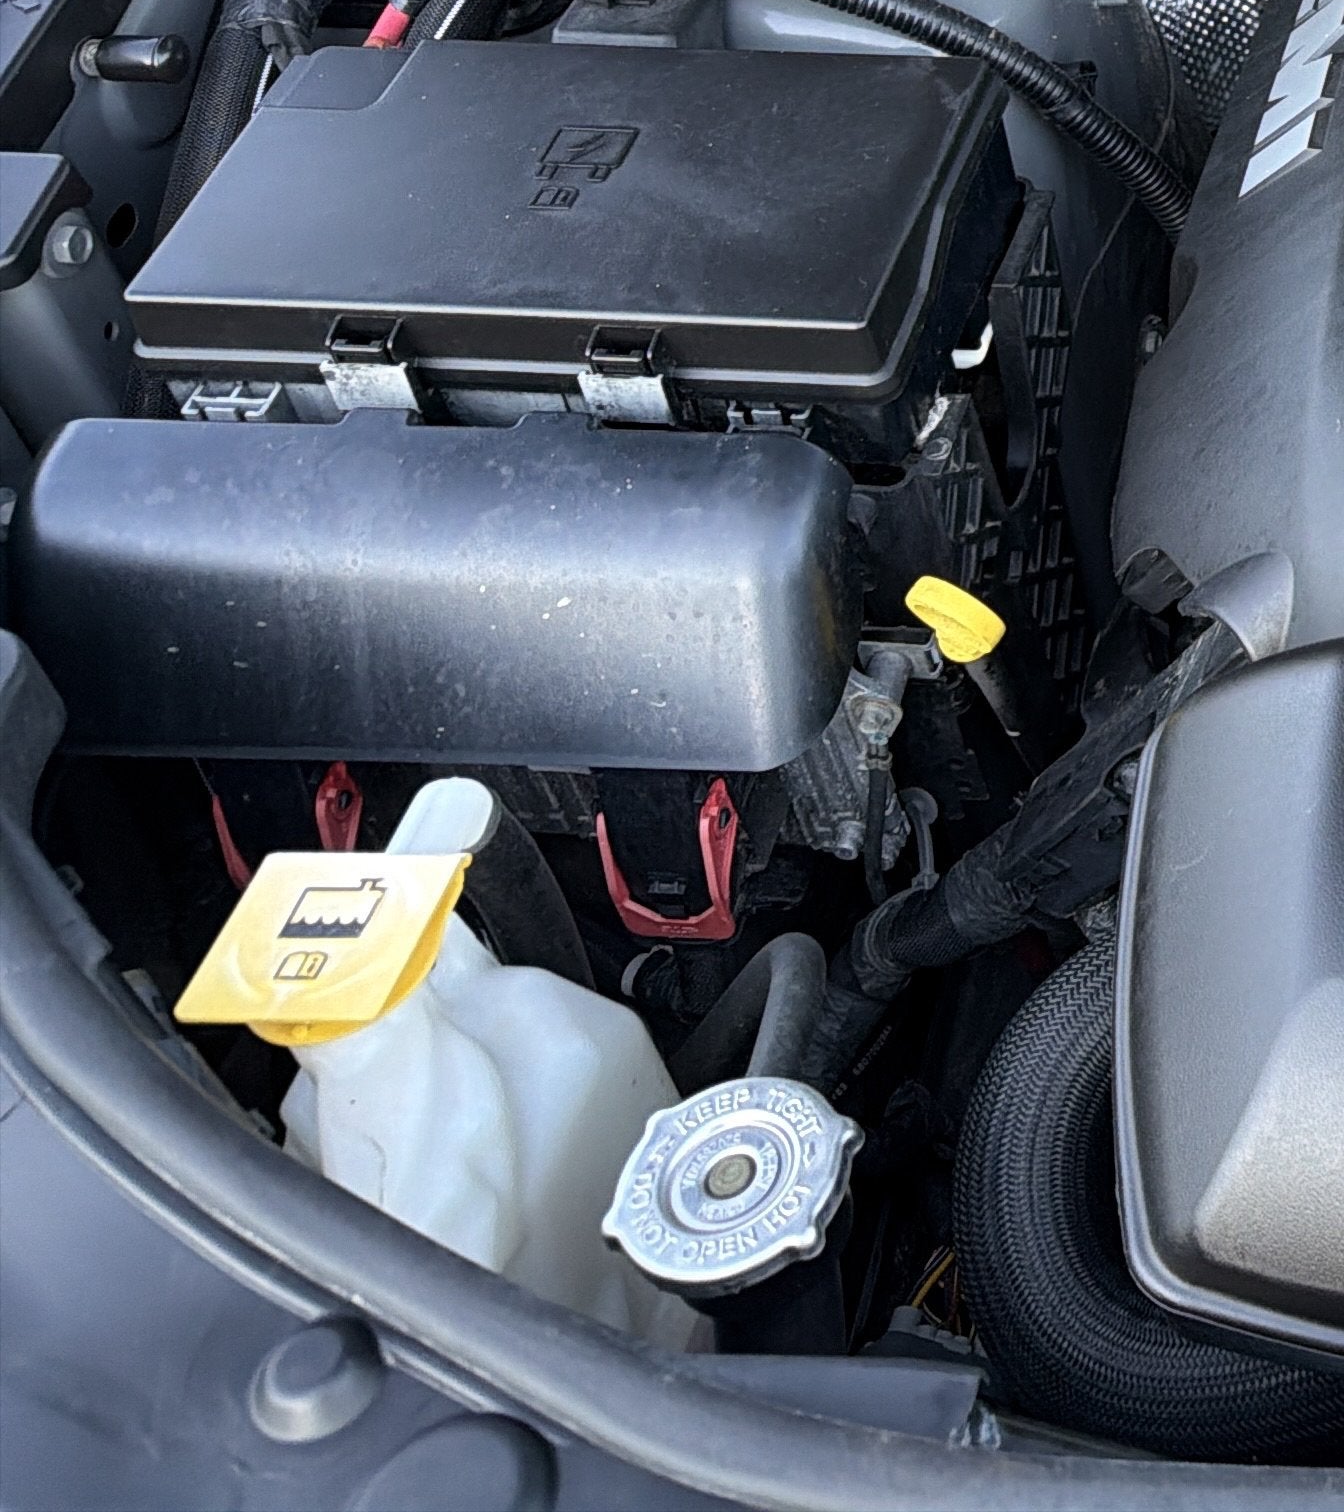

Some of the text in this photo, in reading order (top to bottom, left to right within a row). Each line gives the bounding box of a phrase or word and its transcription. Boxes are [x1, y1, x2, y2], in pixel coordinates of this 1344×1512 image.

[674, 1088, 825, 1138] KEEP TIGHT
[629, 1172, 811, 1265] DO NOT OPEN HOT
